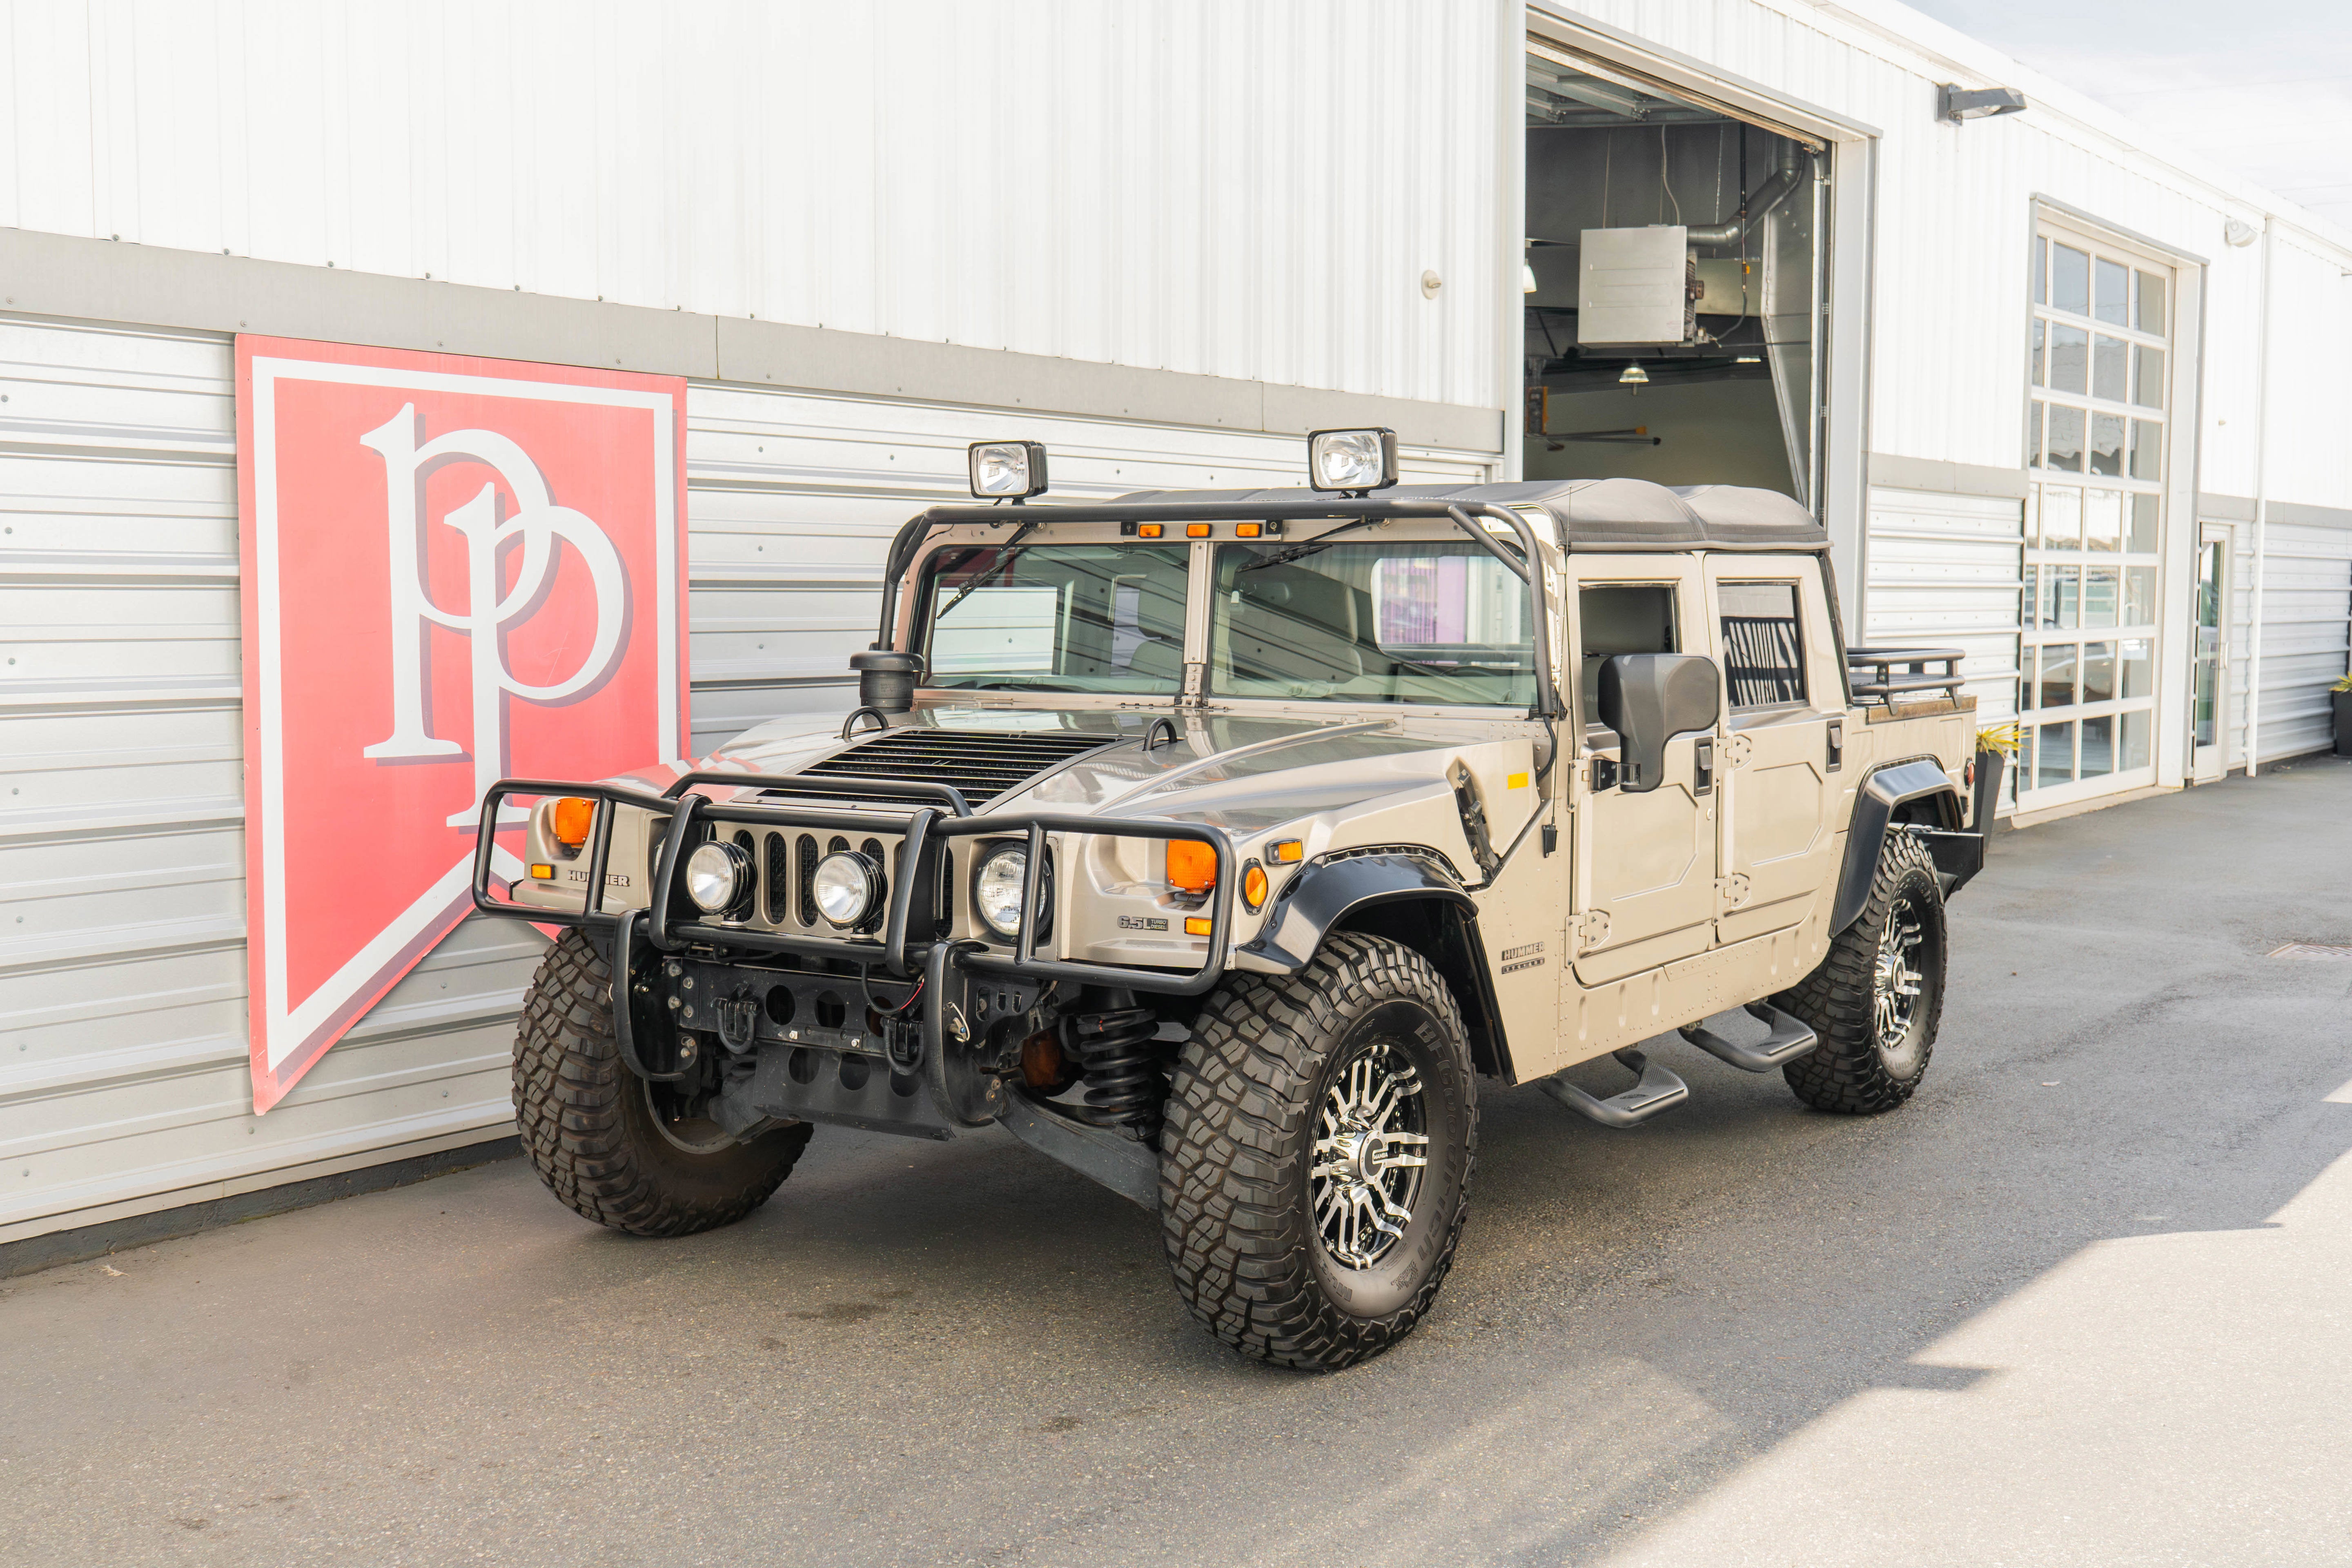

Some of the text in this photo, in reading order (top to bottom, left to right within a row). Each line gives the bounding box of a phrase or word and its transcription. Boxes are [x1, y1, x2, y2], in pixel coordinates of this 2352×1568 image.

[568, 870, 630, 886] HUER
[1117, 915, 1151, 929] 6.5L
[1502, 941, 1545, 961] HUMMER
[1414, 1020, 1458, 1261] BFGoodrich
